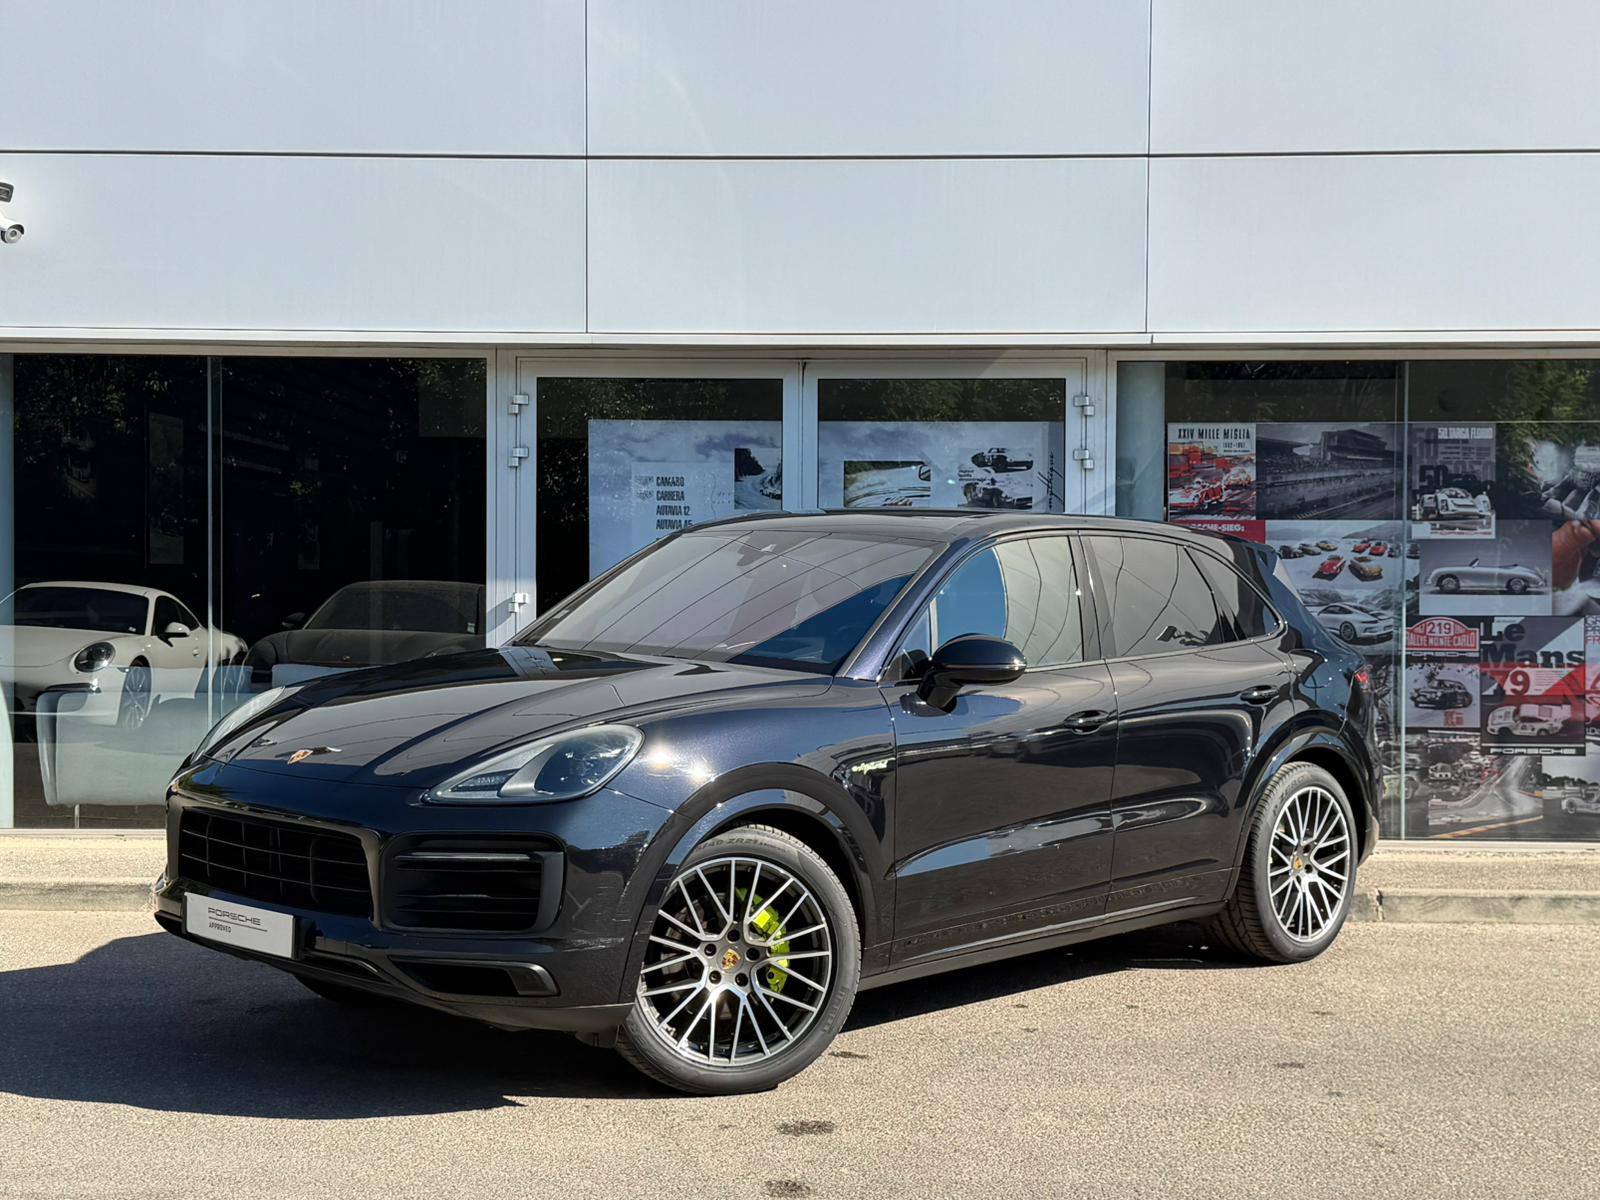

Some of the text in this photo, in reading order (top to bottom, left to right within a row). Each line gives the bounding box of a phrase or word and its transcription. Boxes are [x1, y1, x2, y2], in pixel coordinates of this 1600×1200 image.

[1178, 428, 1195, 440] XXIV
[1198, 428, 1220, 440] MILLE
[656, 491, 685, 501] CARRERA
[1427, 622, 1451, 635] 219
[1480, 616, 1526, 642] Le
[1480, 644, 1584, 669] Mans
[207, 907, 261, 926] PORSCHE
[208, 921, 232, 933] APPROVED
